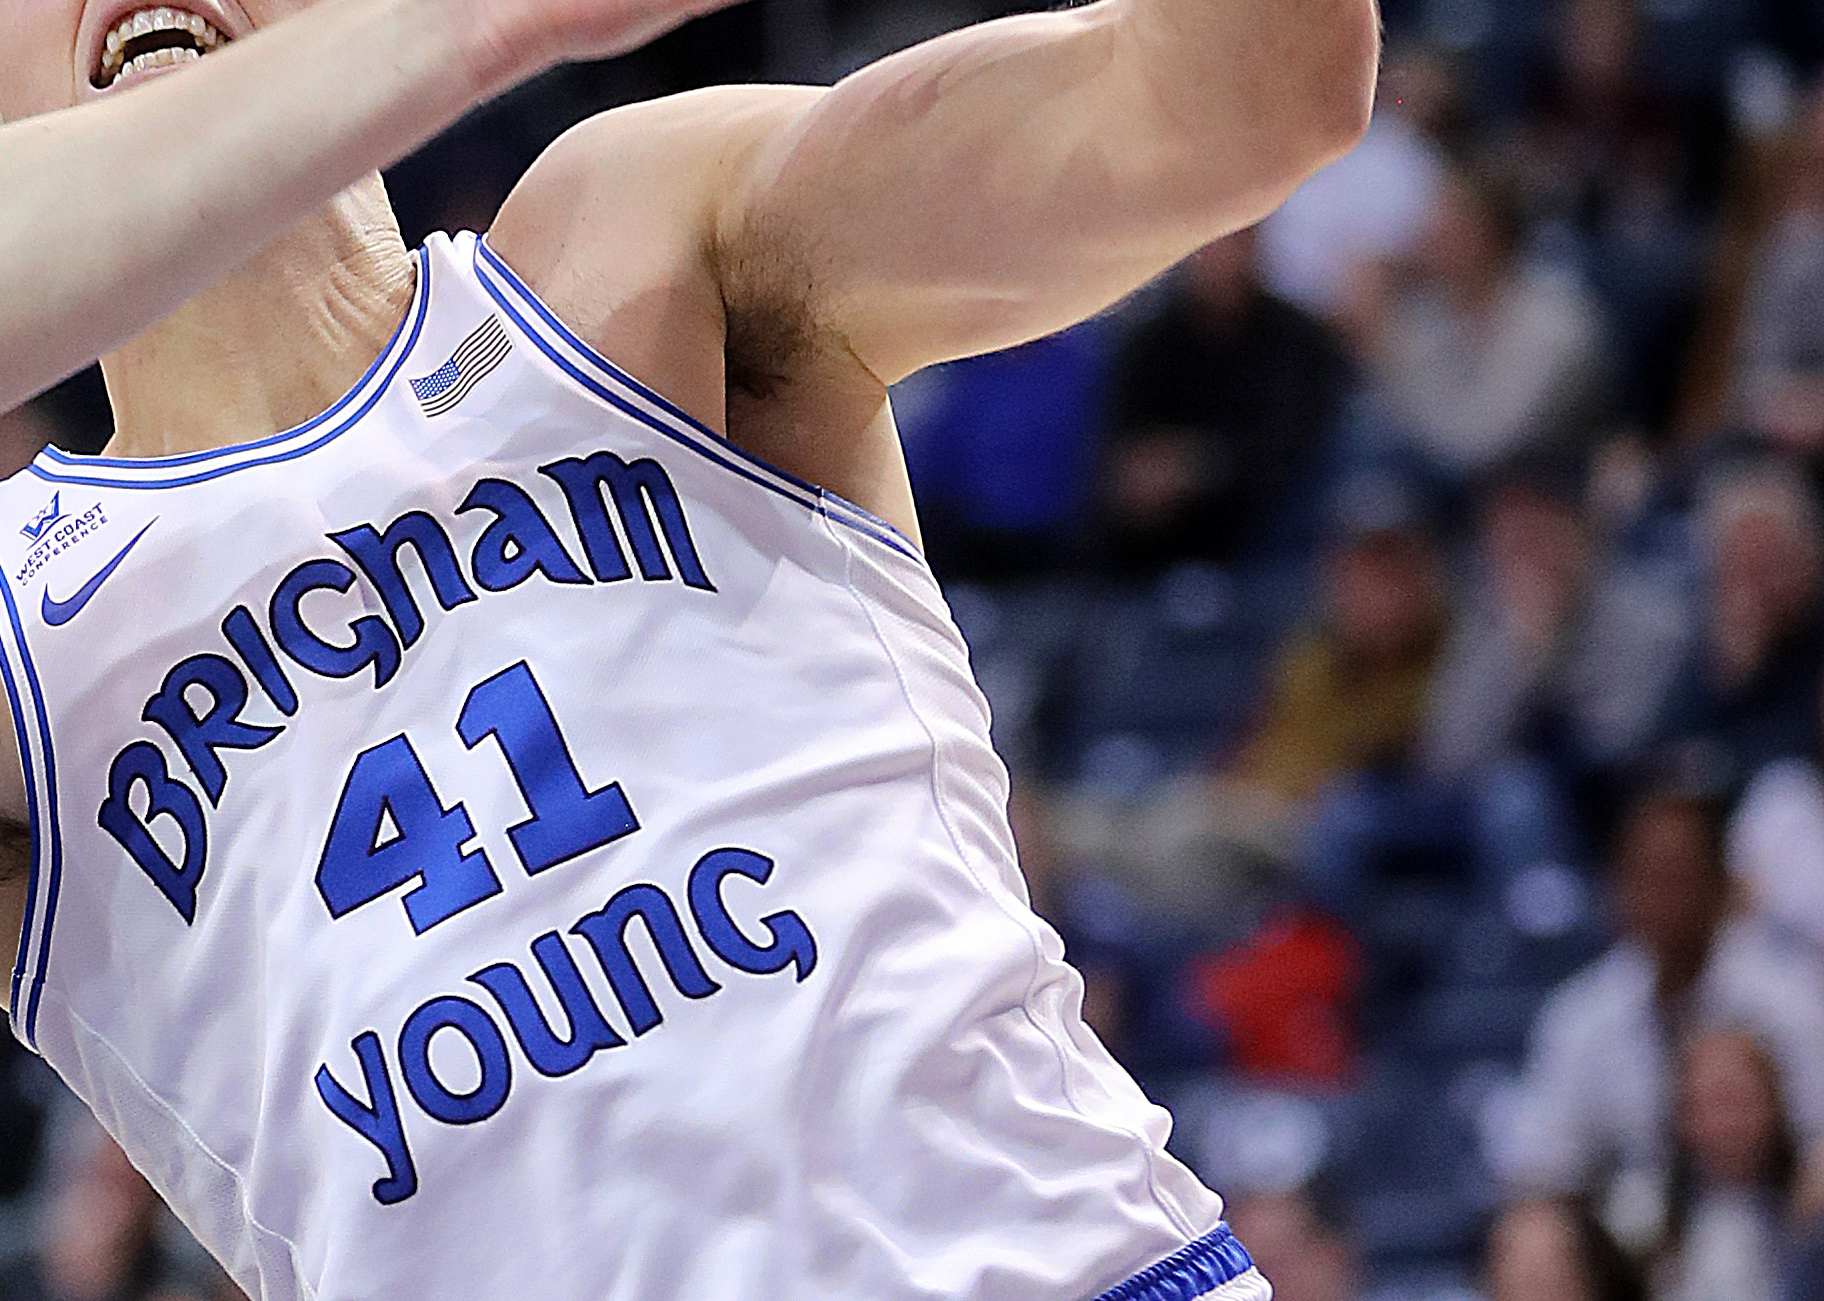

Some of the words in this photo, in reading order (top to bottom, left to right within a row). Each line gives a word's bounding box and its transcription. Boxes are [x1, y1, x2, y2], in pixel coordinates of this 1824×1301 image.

[16, 539, 51, 580] WEST
[54, 502, 103, 542] COAST
[22, 515, 108, 586] CONFERENCE
[314, 659, 642, 937] 41
